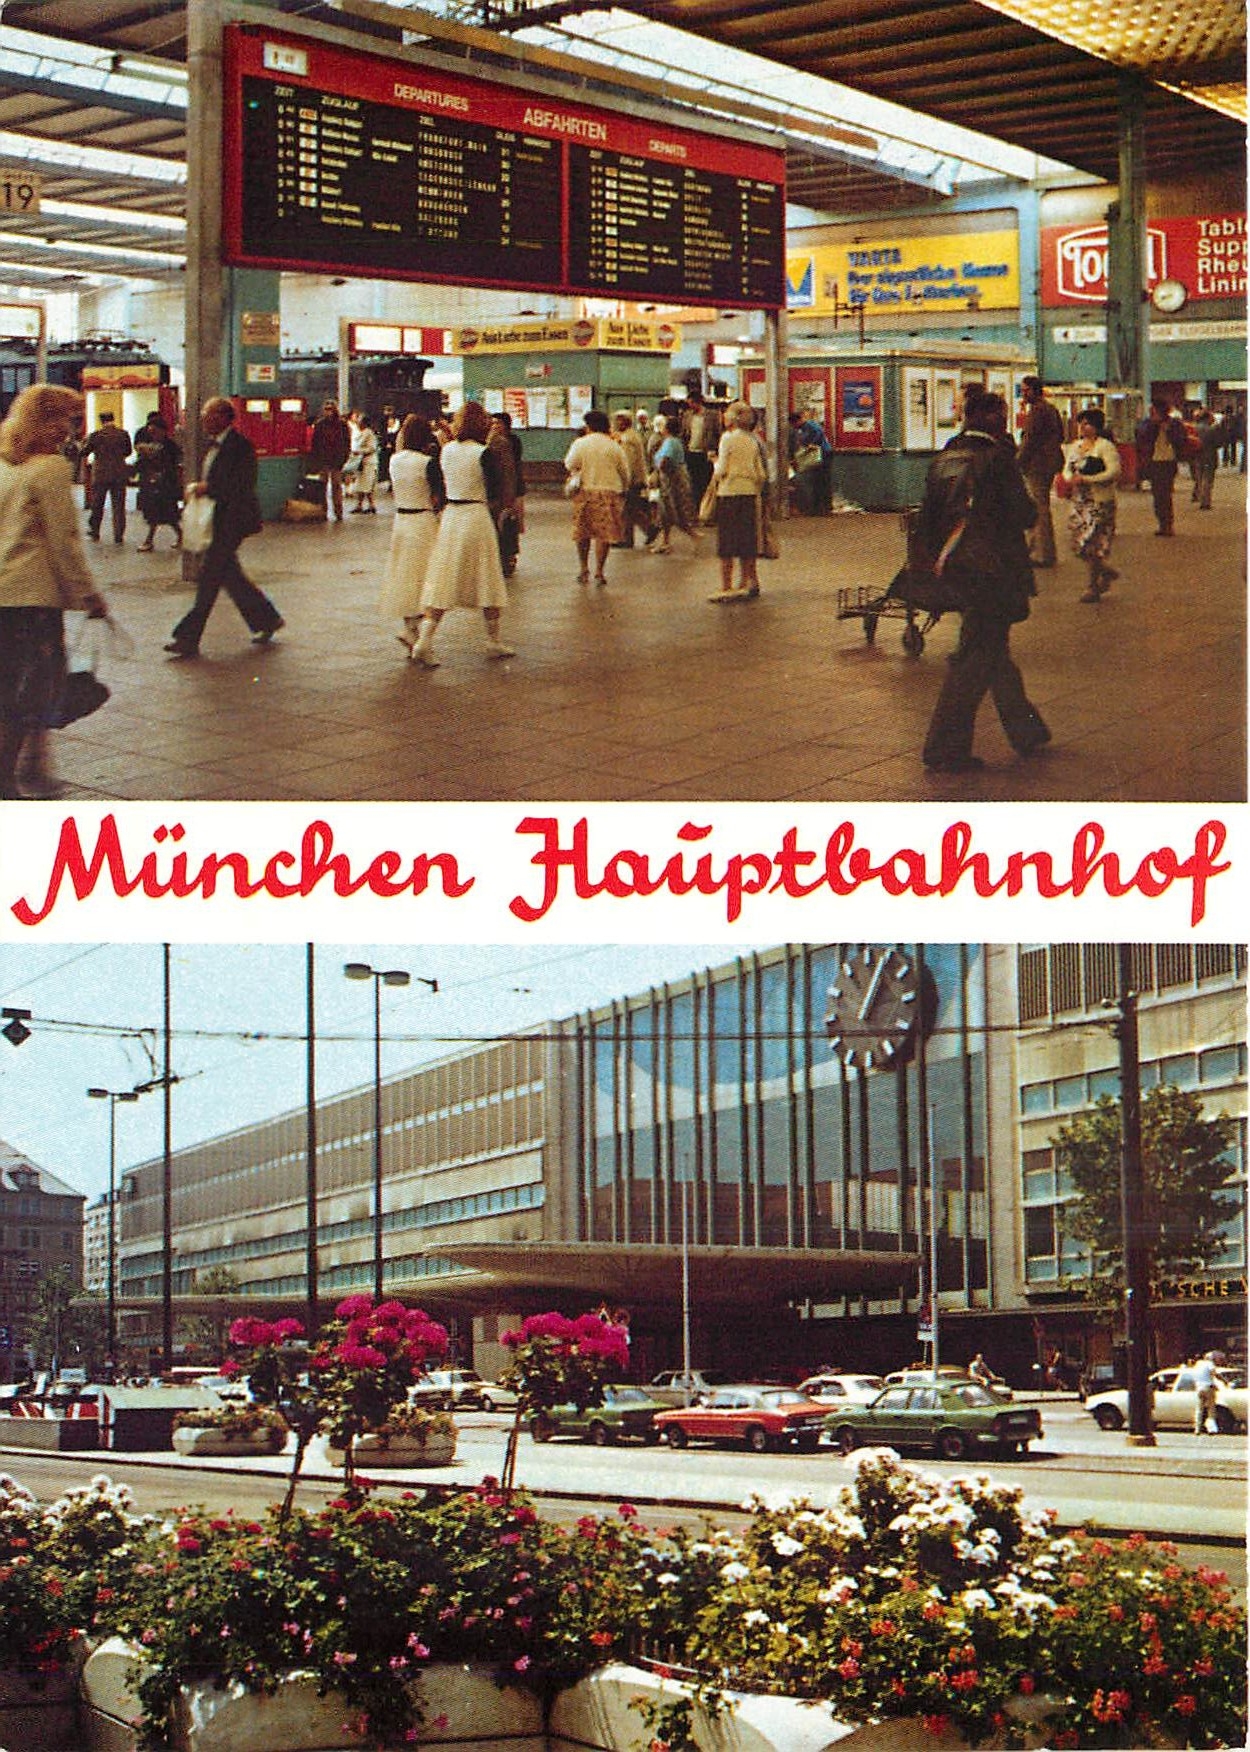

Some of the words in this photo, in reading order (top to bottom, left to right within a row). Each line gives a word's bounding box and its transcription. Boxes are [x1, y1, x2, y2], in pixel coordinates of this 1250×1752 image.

[394, 83, 470, 112] DEPARTURES
[523, 107, 608, 141] ABFAHRTEN
[3, 181, 33, 210] 19
[847, 249, 902, 268] VARTA
[1063, 234, 1158, 288] Tol
